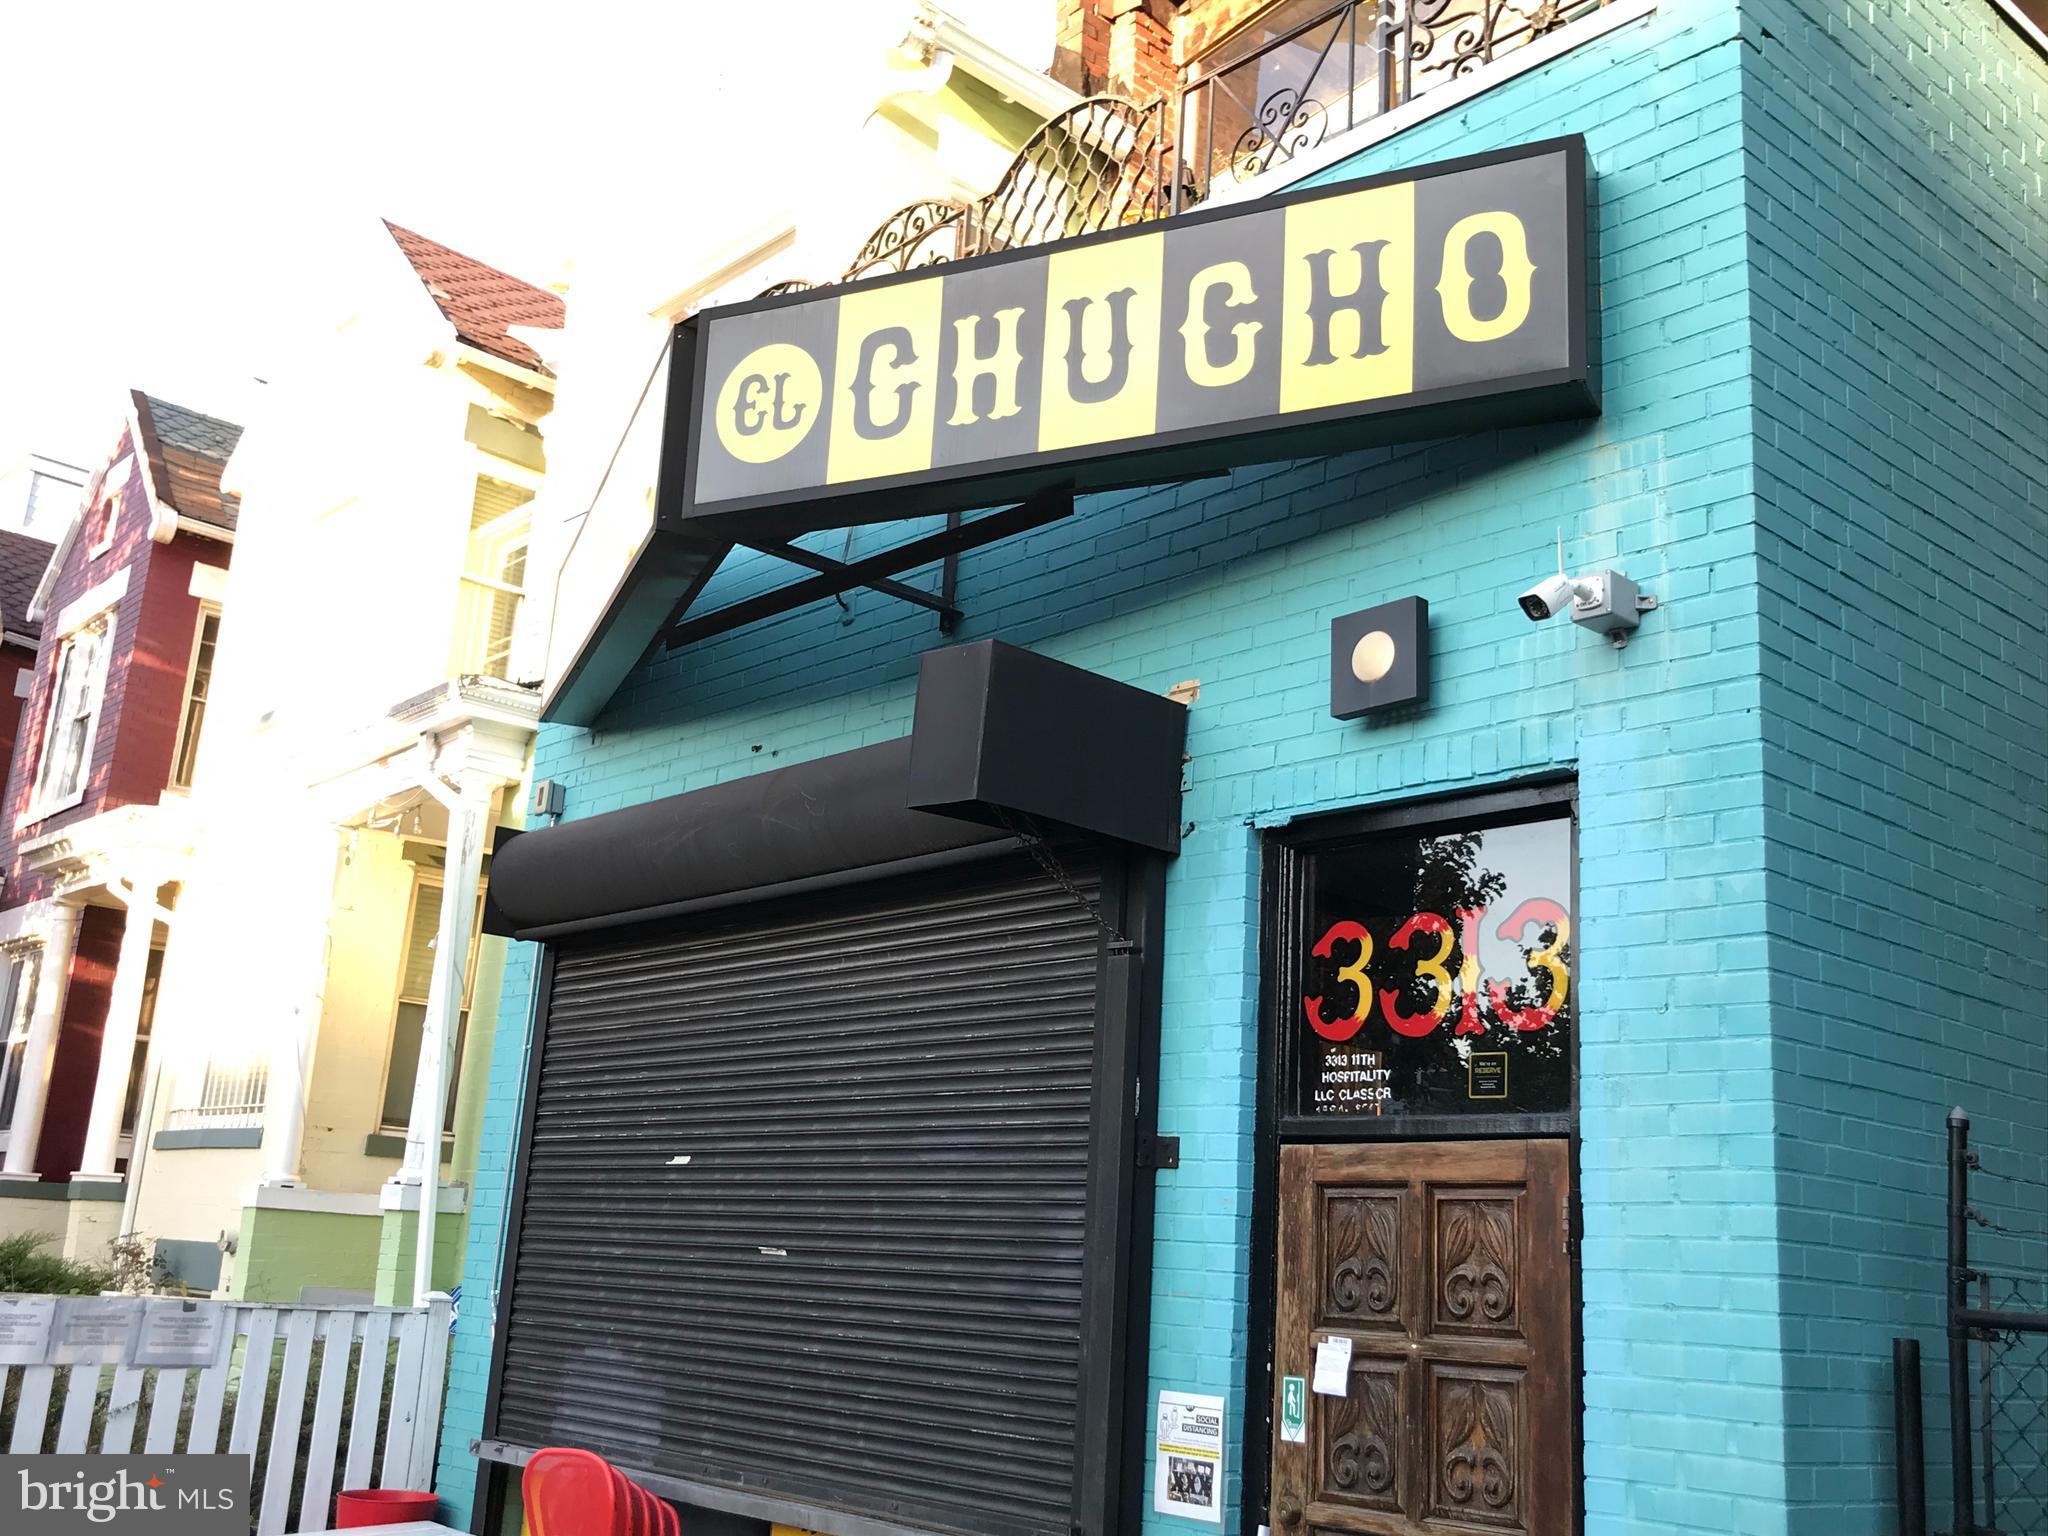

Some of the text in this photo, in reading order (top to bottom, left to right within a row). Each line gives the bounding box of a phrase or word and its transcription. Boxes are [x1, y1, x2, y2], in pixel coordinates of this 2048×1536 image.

[731, 210, 1538, 441] EL CHUCHO
[1303, 896, 1571, 1042] 3313
[1325, 1053, 1376, 1067] 3313 11TH
[1314, 1089, 1335, 1101] LLC
[1197, 1414, 1218, 1425] SOCIAL
[1183, 1424, 1218, 1436] DISTANCING
